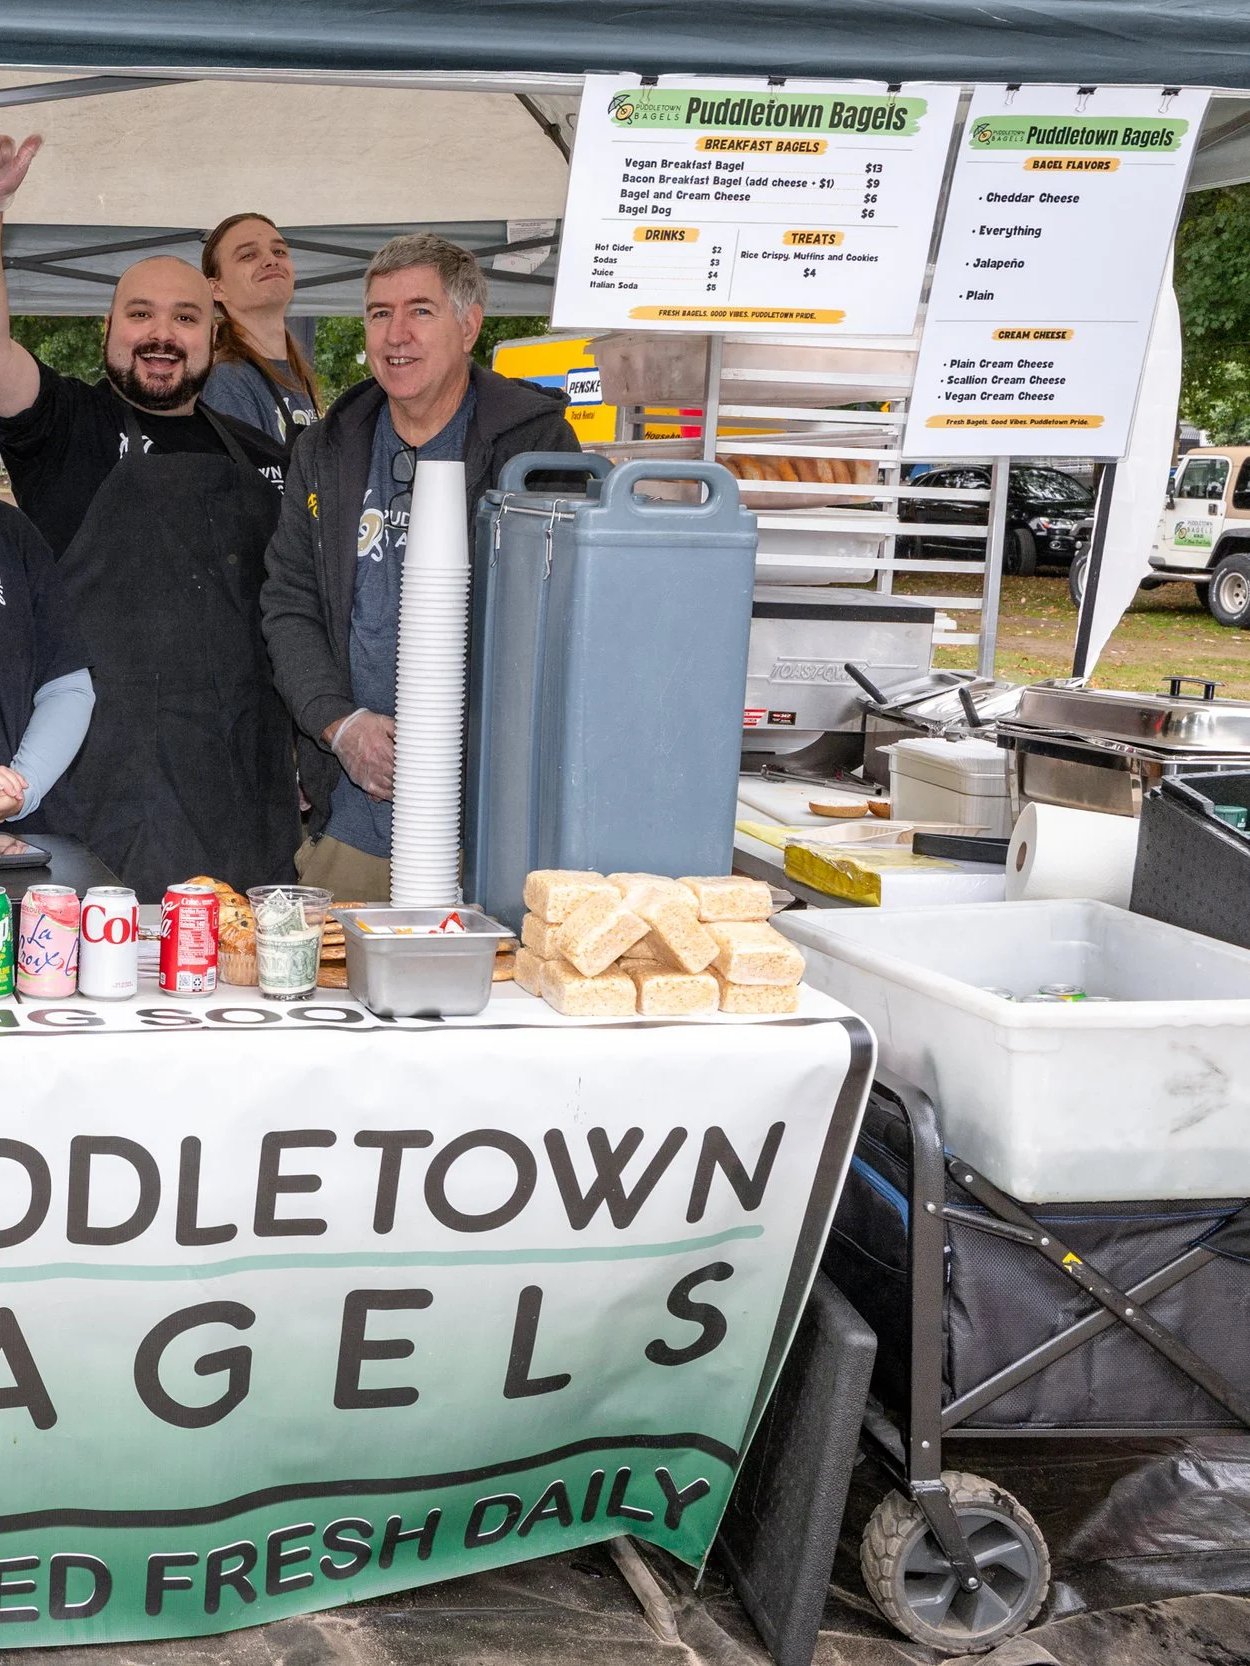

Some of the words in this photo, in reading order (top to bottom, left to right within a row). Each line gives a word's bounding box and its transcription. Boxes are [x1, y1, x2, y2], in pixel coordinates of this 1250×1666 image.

[635, 103, 682, 112] PUDDLETOWN
[634, 112, 680, 121] BAGELS
[685, 97, 825, 129] Puddletown
[828, 102, 908, 133] Bagels
[1026, 126, 1118, 146] Puddletown
[1121, 128, 1175, 148] Bagels
[704, 138, 773, 152] BREAKFAST
[776, 141, 820, 153] BAGELS
[625, 158, 658, 170] Vegan
[660, 158, 712, 170] Breakfast
[714, 160, 745, 172] Bagel
[865, 162, 883, 174] $13
[1066, 160, 1111, 170] FLAVORS
[622, 174, 654, 184] Bacon
[658, 174, 710, 185] Breakfast
[712, 176, 742, 188] Bagel
[745, 176, 768, 187] (add
[772, 178, 808, 189] cheese
[819, 179, 835, 190] $1)
[866, 178, 880, 189] $9
[620, 189, 650, 201] Bagel
[651, 190, 673, 200] and
[676, 191, 710, 201] Cream
[714, 192, 750, 202] Cheese
[863, 193, 878, 204] $6
[986, 192, 1035, 203] Cheddar
[1039, 193, 1080, 204] Cheese
[618, 204, 648, 216] Bagel
[651, 205, 672, 217] Dog
[861, 208, 875, 219] $6
[645, 229, 686, 241] DRINKS
[979, 225, 1042, 238] Everything
[792, 233, 836, 245] TREATS
[595, 243, 609, 251] Hot
[612, 244, 633, 252] Cider
[712, 246, 722, 254] $2
[593, 256, 618, 264] Sodas
[710, 258, 720, 266] $3
[741, 251, 758, 259] Rice
[794, 252, 825, 260] Muffins
[828, 253, 843, 261] and
[846, 254, 878, 262] Cookies
[972, 258, 1025, 270] Jalapeño
[592, 268, 614, 276] Juice
[708, 271, 718, 279] $4
[803, 268, 817, 278] $4
[590, 281, 615, 289] Italian
[618, 282, 638, 290] Soda
[966, 290, 994, 301] Plain
[998, 331, 1031, 340] CREAM
[1033, 331, 1067, 340] CHEESE
[950, 359, 976, 369] Plain
[979, 359, 1014, 369] Cream
[1016, 359, 1054, 369] Cheese
[947, 375, 988, 385] Scallion
[991, 376, 1026, 385] Cream
[1029, 376, 1066, 385] Cheese
[569, 380, 600, 394] PENSKE
[945, 392, 977, 402] Vegan
[980, 392, 1014, 401] Cream
[1017, 392, 1055, 401] Cheese
[145, 1507, 442, 1616] FRESH
[463, 1465, 711, 1548] DAILY
